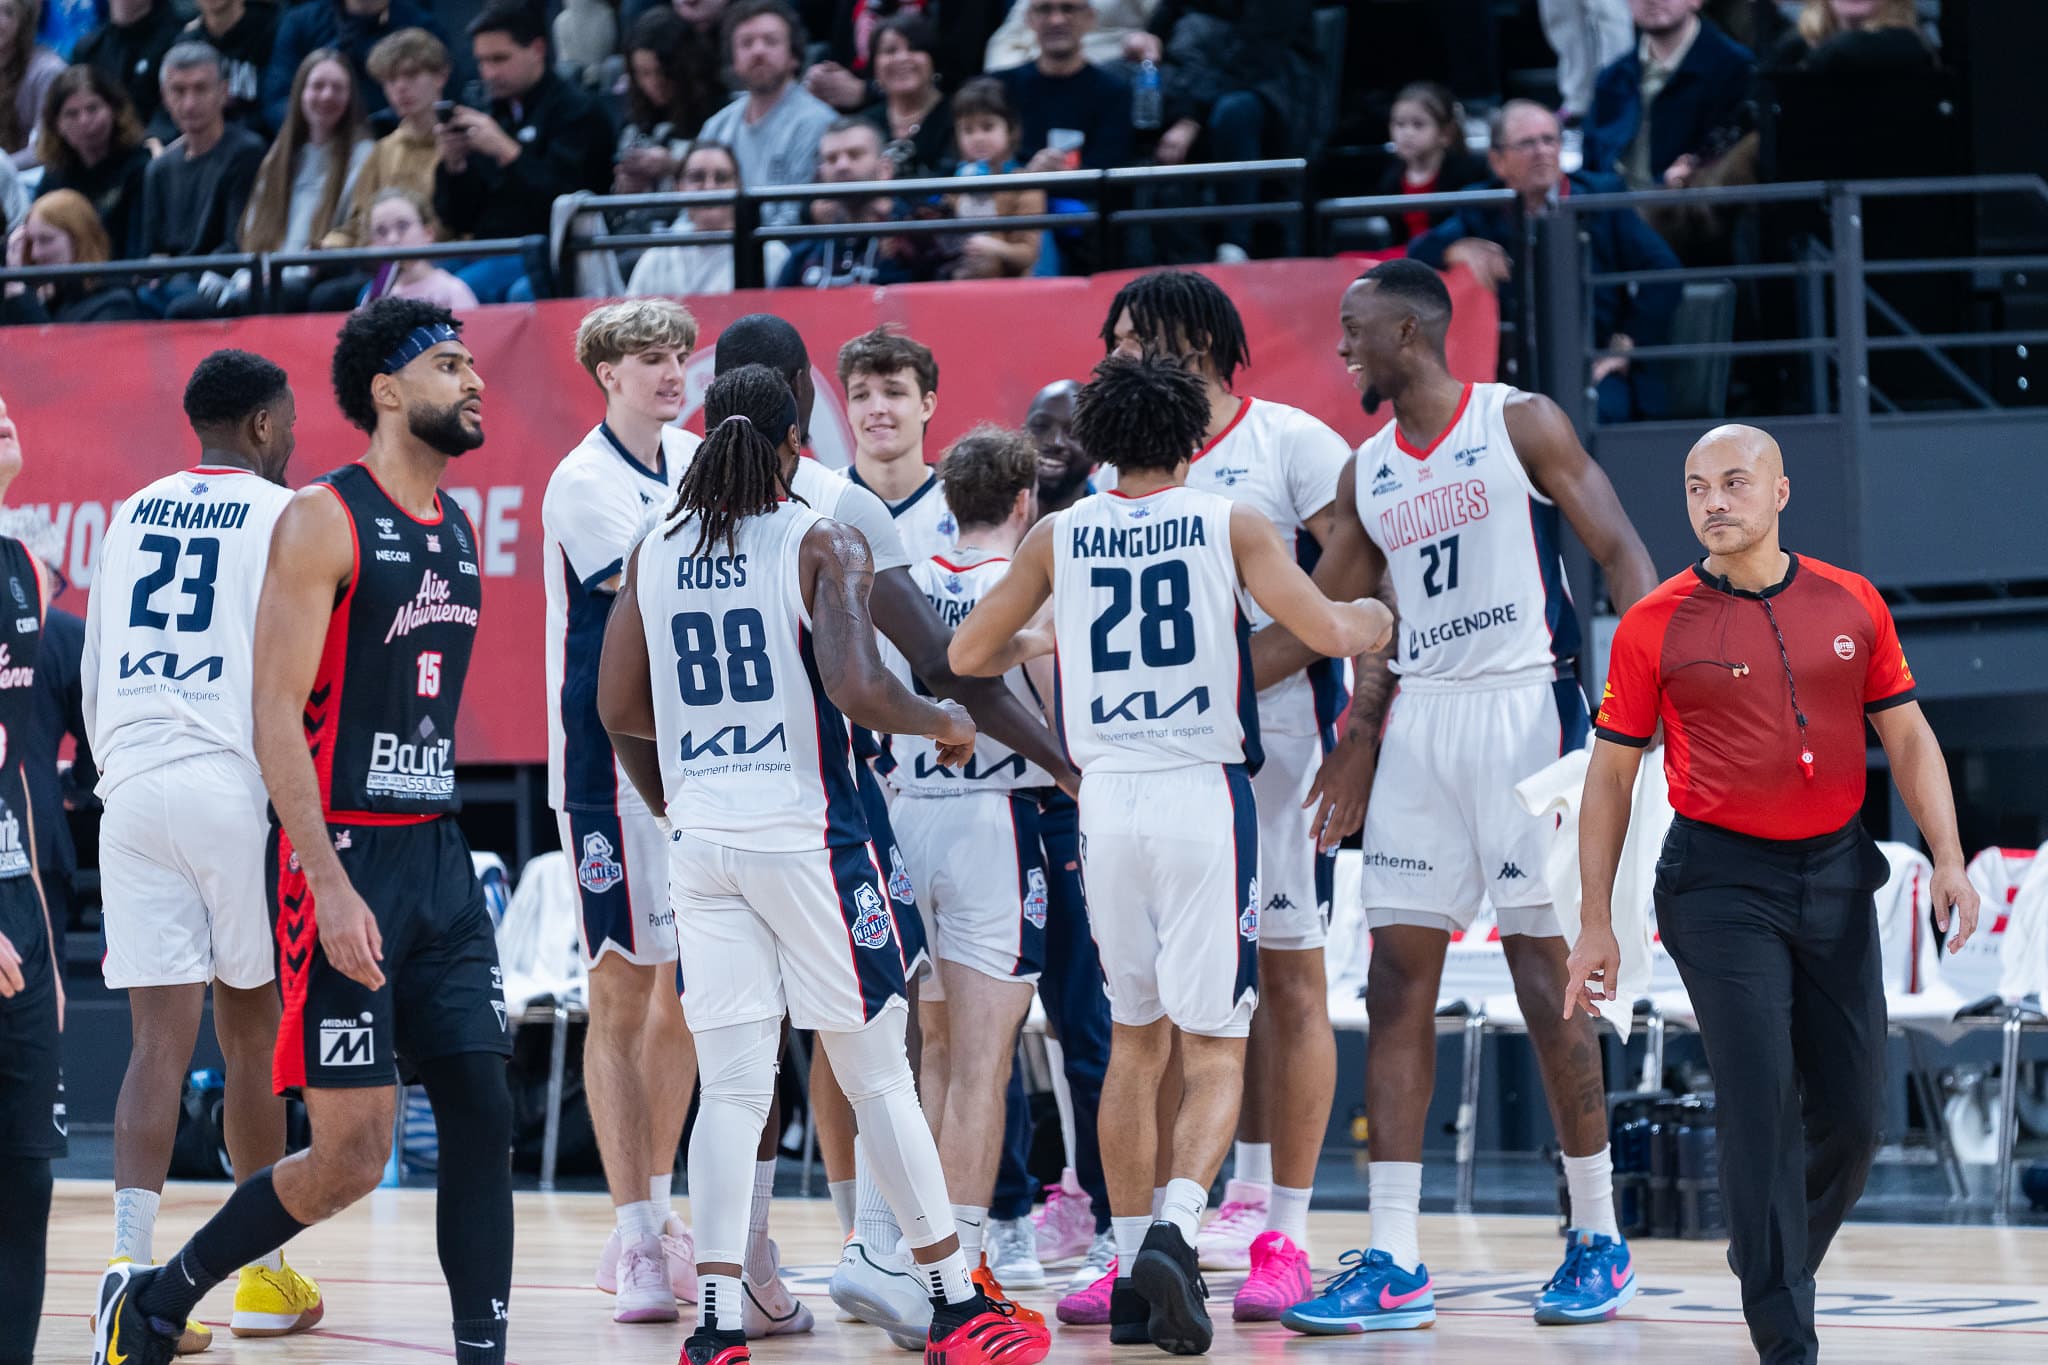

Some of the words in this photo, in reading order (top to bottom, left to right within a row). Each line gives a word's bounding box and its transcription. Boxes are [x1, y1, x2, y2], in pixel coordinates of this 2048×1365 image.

[130, 498, 250, 529] MIENANDI
[1380, 480, 1489, 551] NANTES
[1073, 515, 1206, 559] KANGUDIA
[129, 533, 220, 632] 23
[678, 554, 747, 590] ROSS
[1420, 534, 1459, 598] 27
[416, 569, 450, 608] Aix
[384, 601, 478, 645] Maurienne
[1090, 559, 1196, 673] 28
[1421, 603, 1518, 649] LEGENDRE
[417, 651, 443, 698] 15
[671, 608, 774, 706] 88
[1147, 728, 1168, 739] that
[1172, 725, 1214, 739] inspires
[732, 762, 752, 773] that
[755, 761, 791, 775] inspire
[579, 866, 620, 881] NANTES
[1363, 852, 1433, 871] arthema.
[855, 914, 888, 942] NANTES
[320, 1018, 357, 1028] MIDALI
